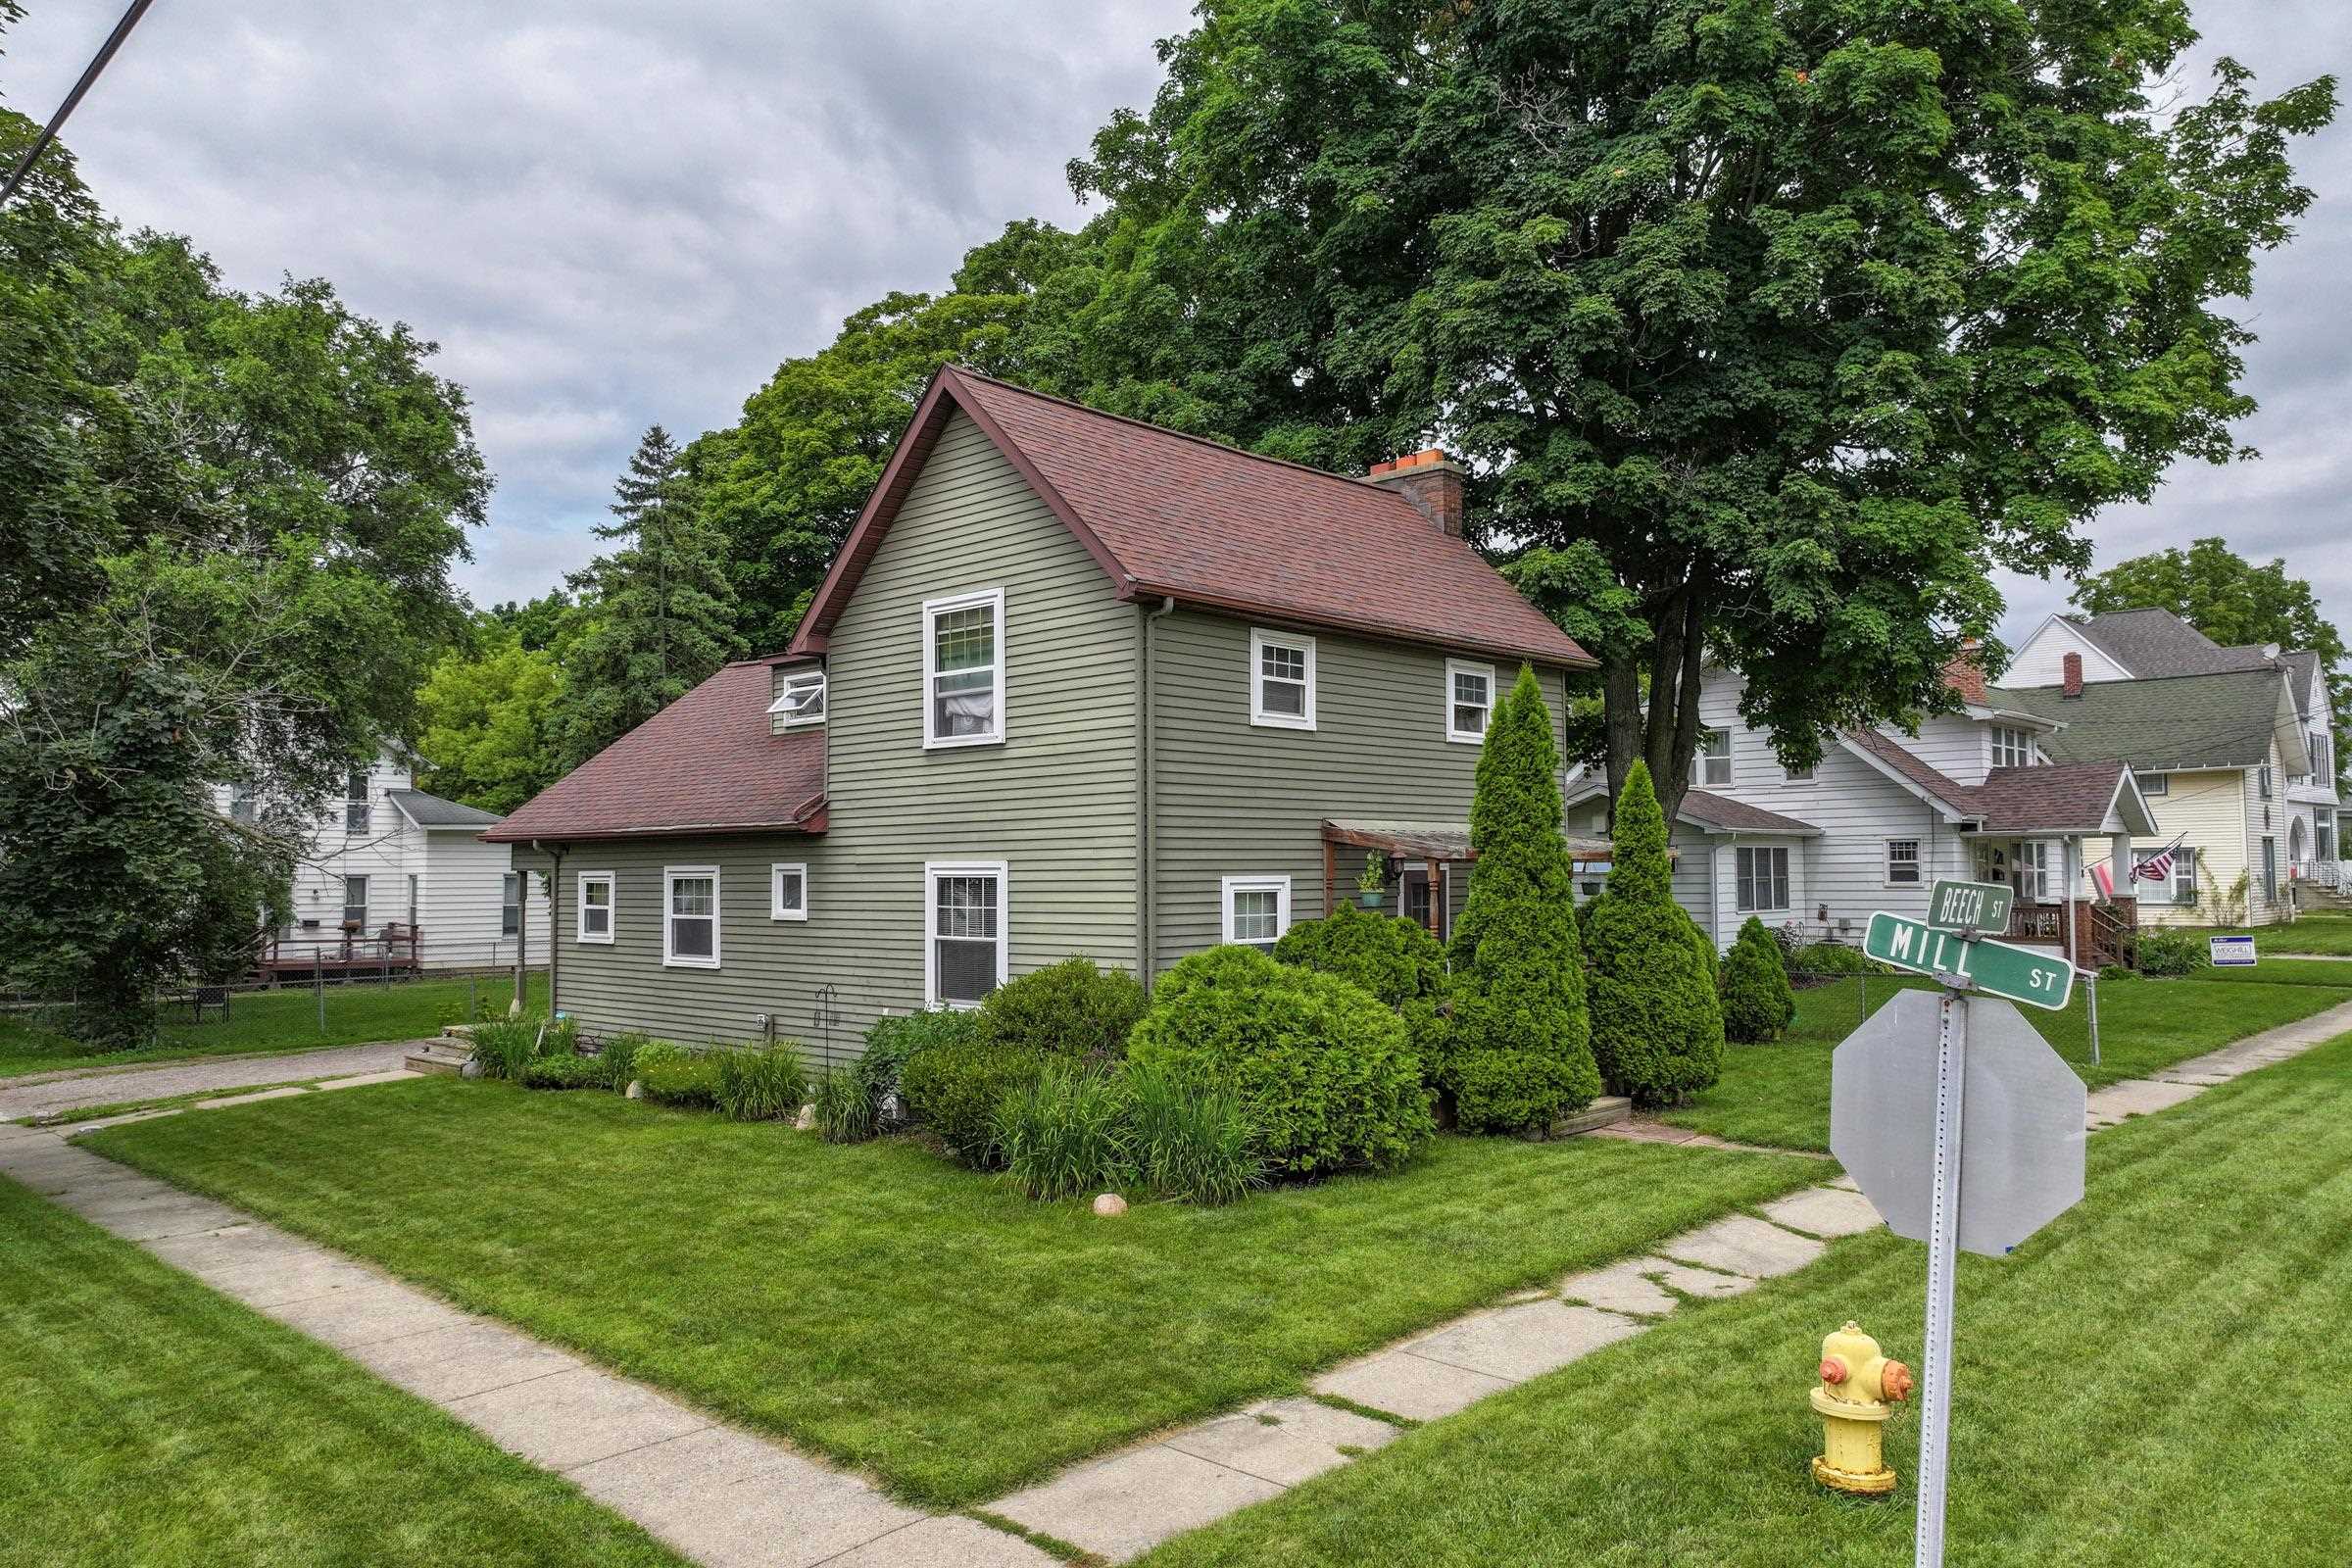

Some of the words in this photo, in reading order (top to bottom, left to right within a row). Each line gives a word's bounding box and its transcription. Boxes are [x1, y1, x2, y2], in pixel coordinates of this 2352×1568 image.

[1940, 887, 1984, 924] BEECH
[1991, 900, 2003, 918] ST
[1889, 923, 1972, 978] MILL
[2029, 968, 2056, 991] ST
